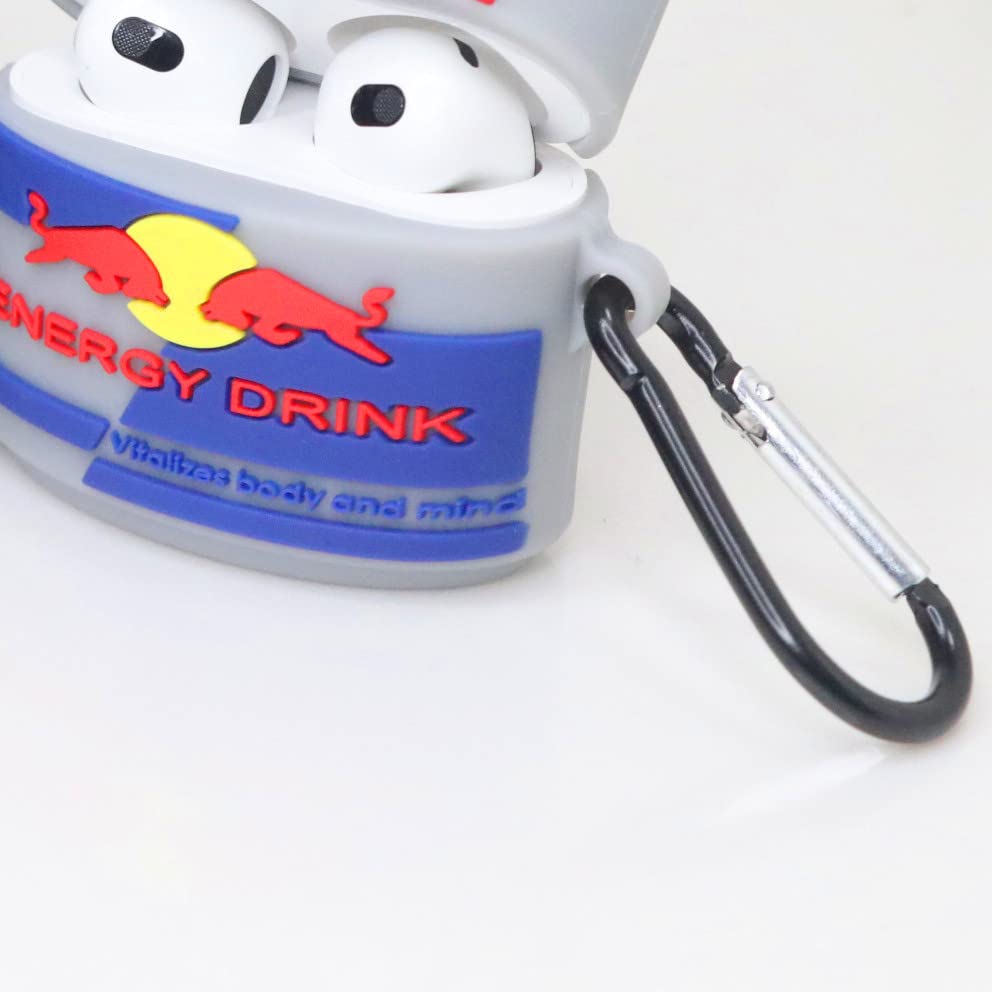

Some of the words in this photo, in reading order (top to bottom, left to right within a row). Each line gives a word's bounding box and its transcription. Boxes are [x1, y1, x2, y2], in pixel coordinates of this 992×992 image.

[229, 376, 474, 445] DRINK
[110, 429, 231, 489] Vitalizes
[235, 468, 327, 510] body
[331, 493, 407, 520] and
[416, 486, 528, 522] mind
